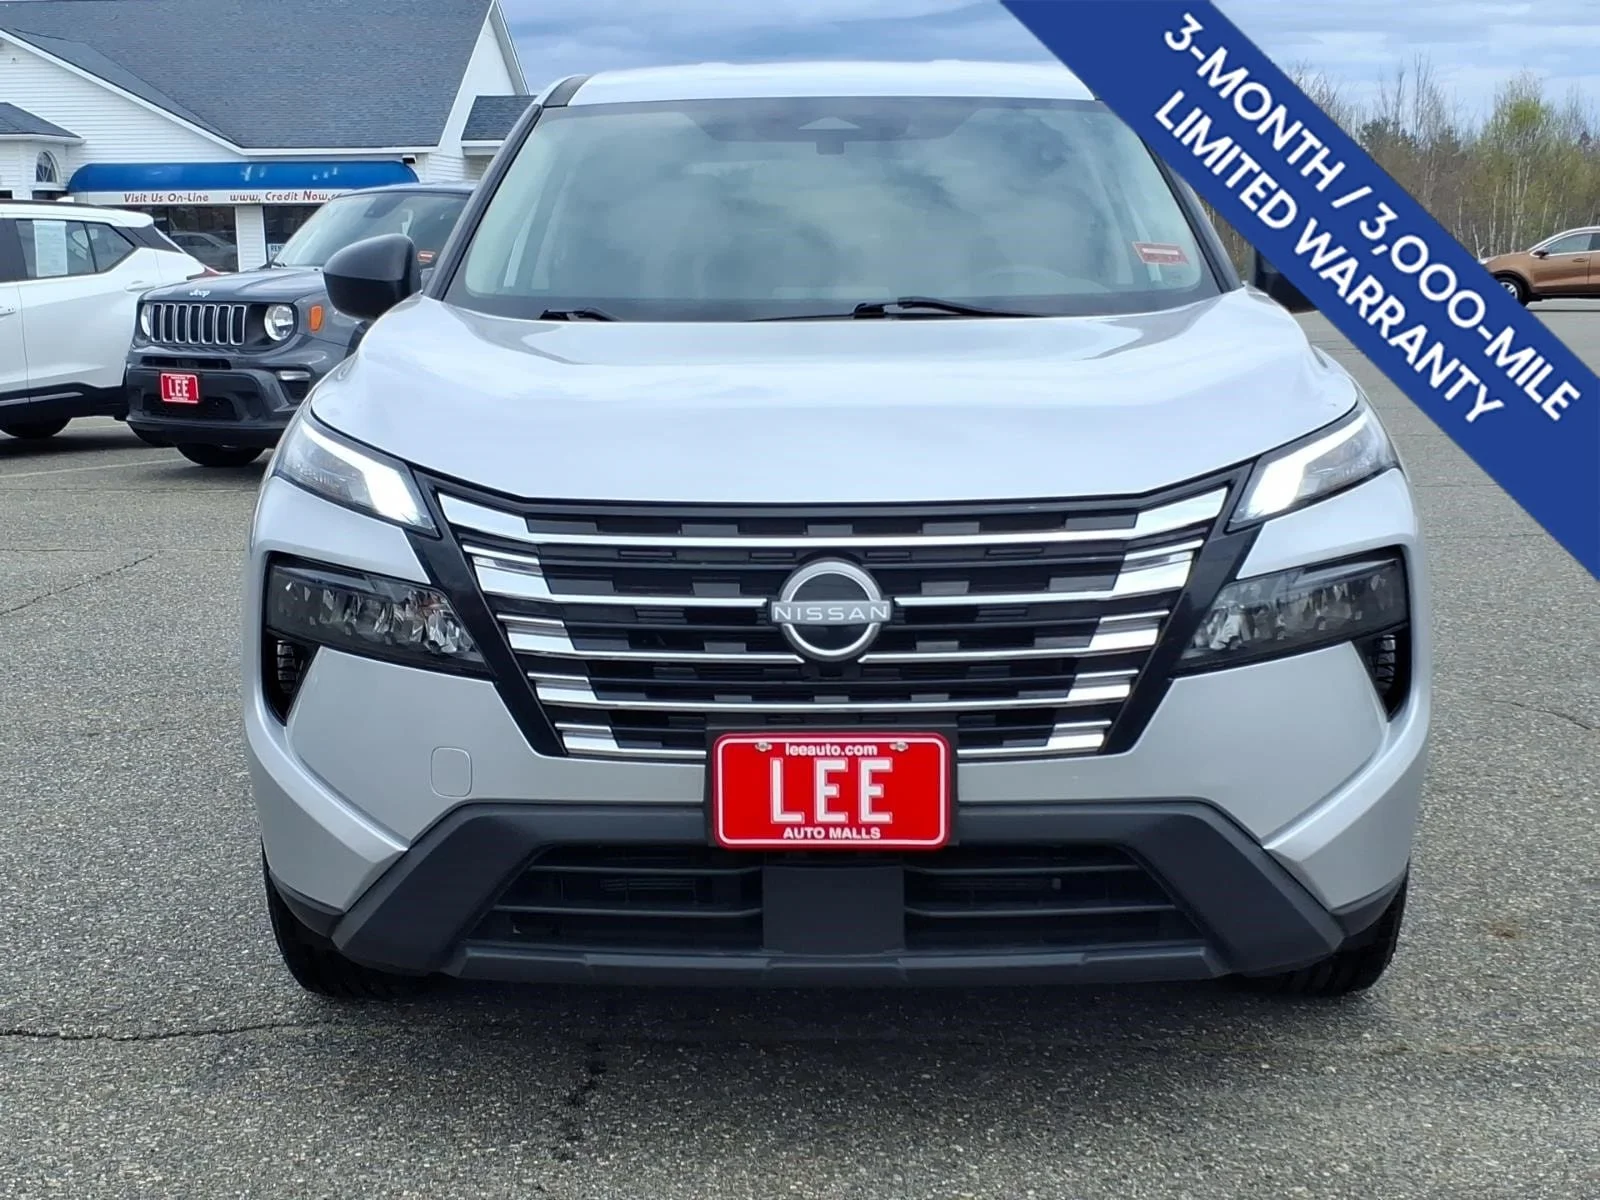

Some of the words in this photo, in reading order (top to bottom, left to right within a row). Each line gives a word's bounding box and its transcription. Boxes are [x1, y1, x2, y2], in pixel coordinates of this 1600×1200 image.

[124, 193, 147, 203] Visit
[151, 193, 163, 202] Us
[167, 193, 209, 202] On-Line
[265, 191, 298, 201] Credit
[168, 379, 190, 397] LEE
[774, 606, 888, 621] NISSAN
[785, 742, 878, 756] leeauto.com
[770, 757, 893, 824] LEE
[783, 827, 825, 839] AUTO
[829, 827, 881, 839] MALLS
